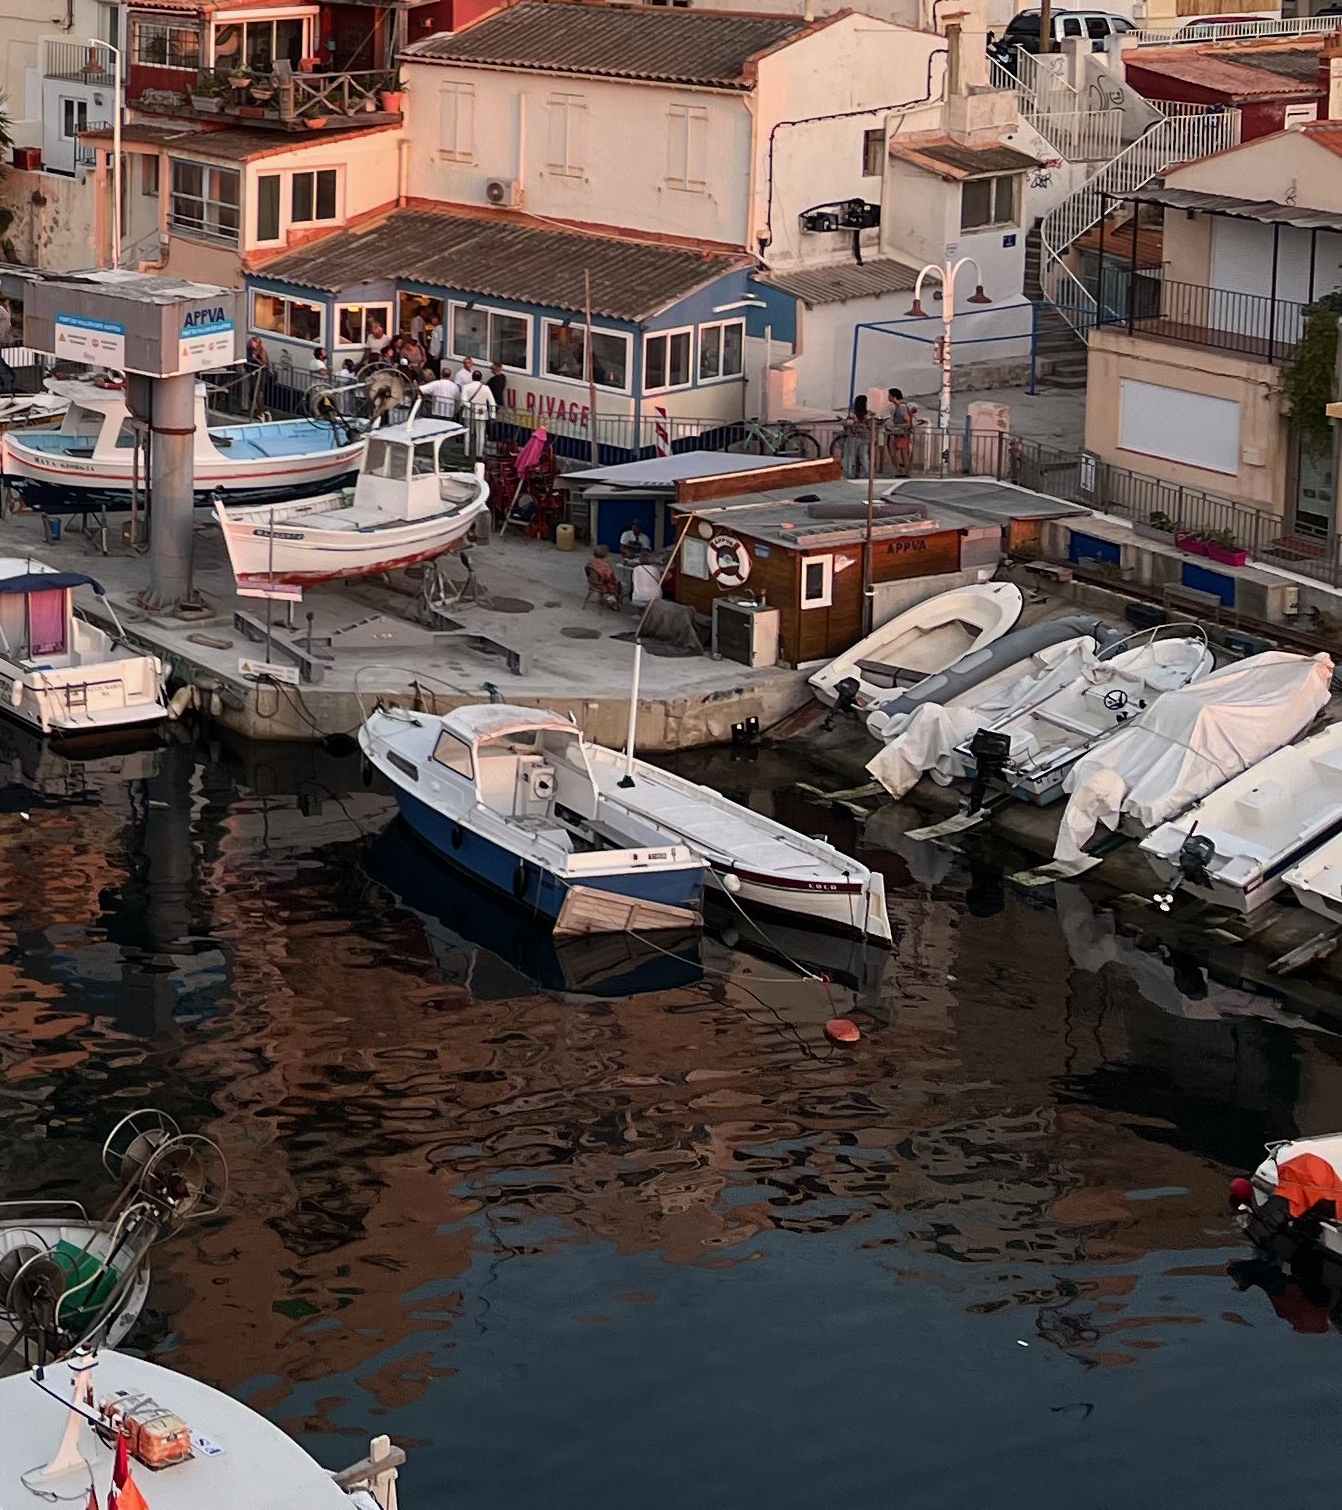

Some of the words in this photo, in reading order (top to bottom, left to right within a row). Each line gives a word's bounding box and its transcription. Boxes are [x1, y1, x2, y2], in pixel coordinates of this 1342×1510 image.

[184, 306, 225, 328] APPVA
[526, 392, 589, 427] RIVAGE
[887, 540, 927, 554] APPVA
